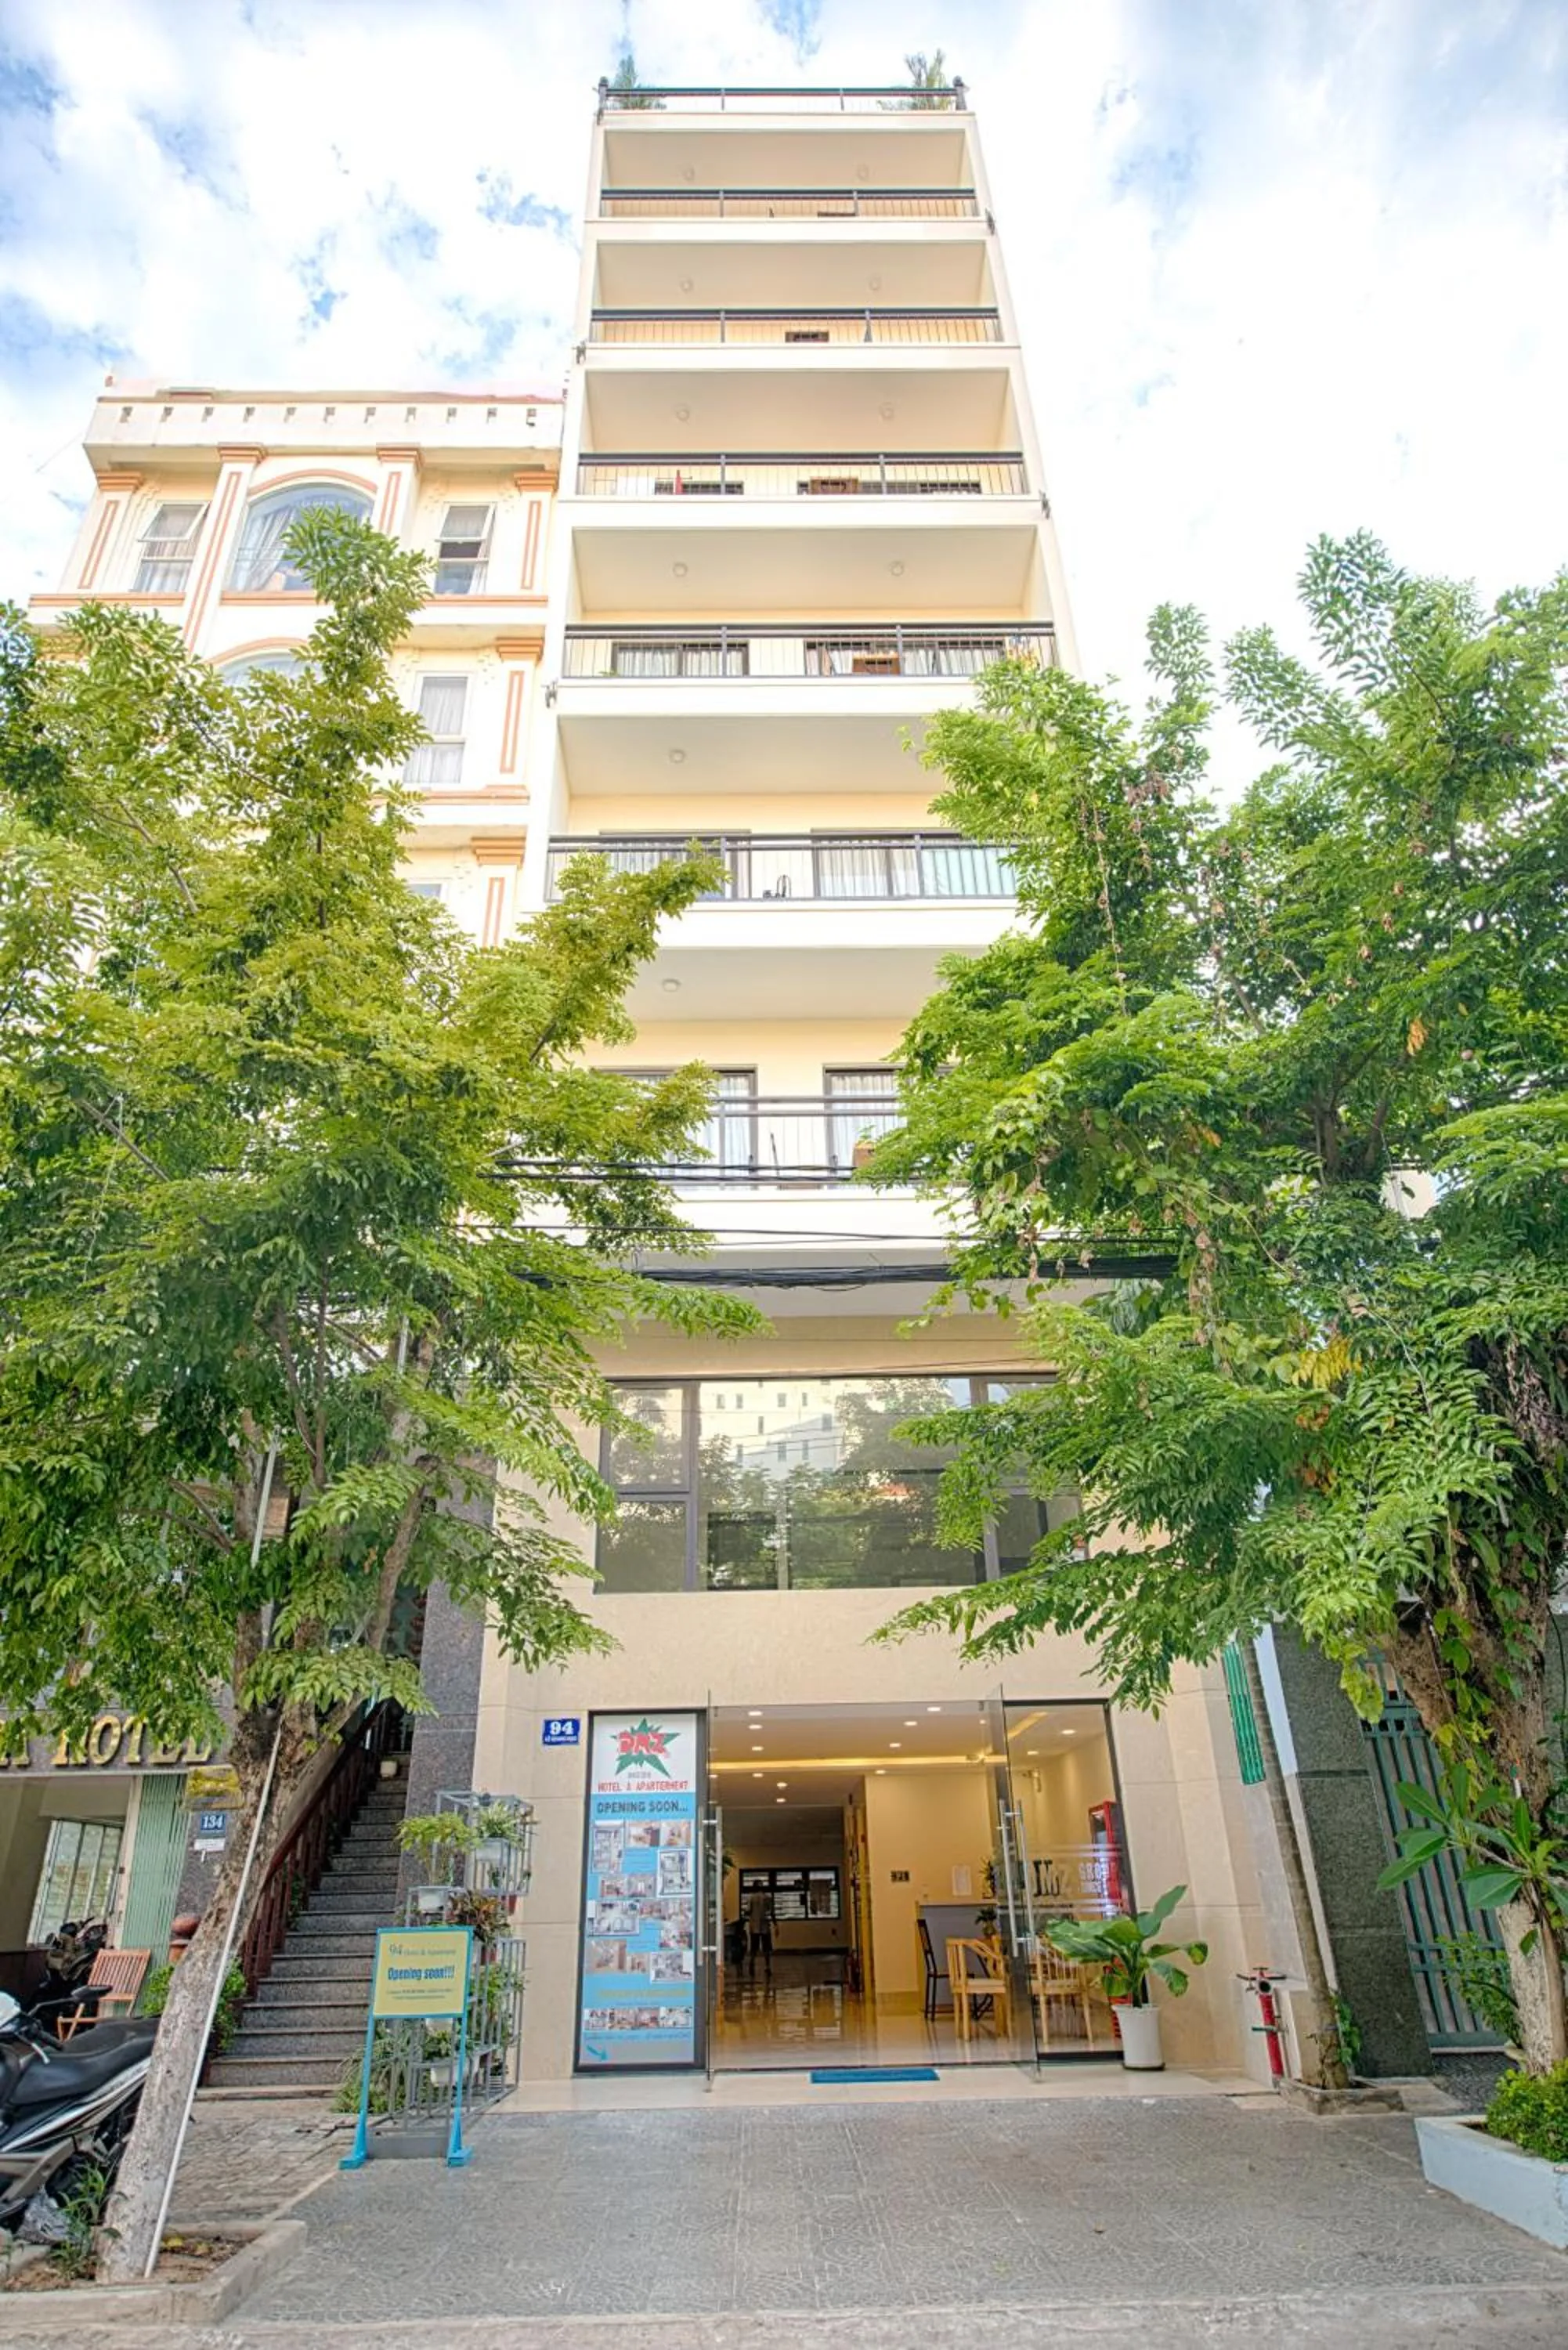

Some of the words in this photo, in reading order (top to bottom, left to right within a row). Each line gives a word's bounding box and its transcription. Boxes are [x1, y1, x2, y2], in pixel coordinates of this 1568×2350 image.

[550, 1721, 573, 1734] 94
[617, 1731, 667, 1755] DMZ
[598, 1781, 622, 1792] HOTEL
[597, 1802, 645, 1814] OPENING
[203, 1815, 223, 1828] 134
[388, 1967, 422, 1981] Opening
